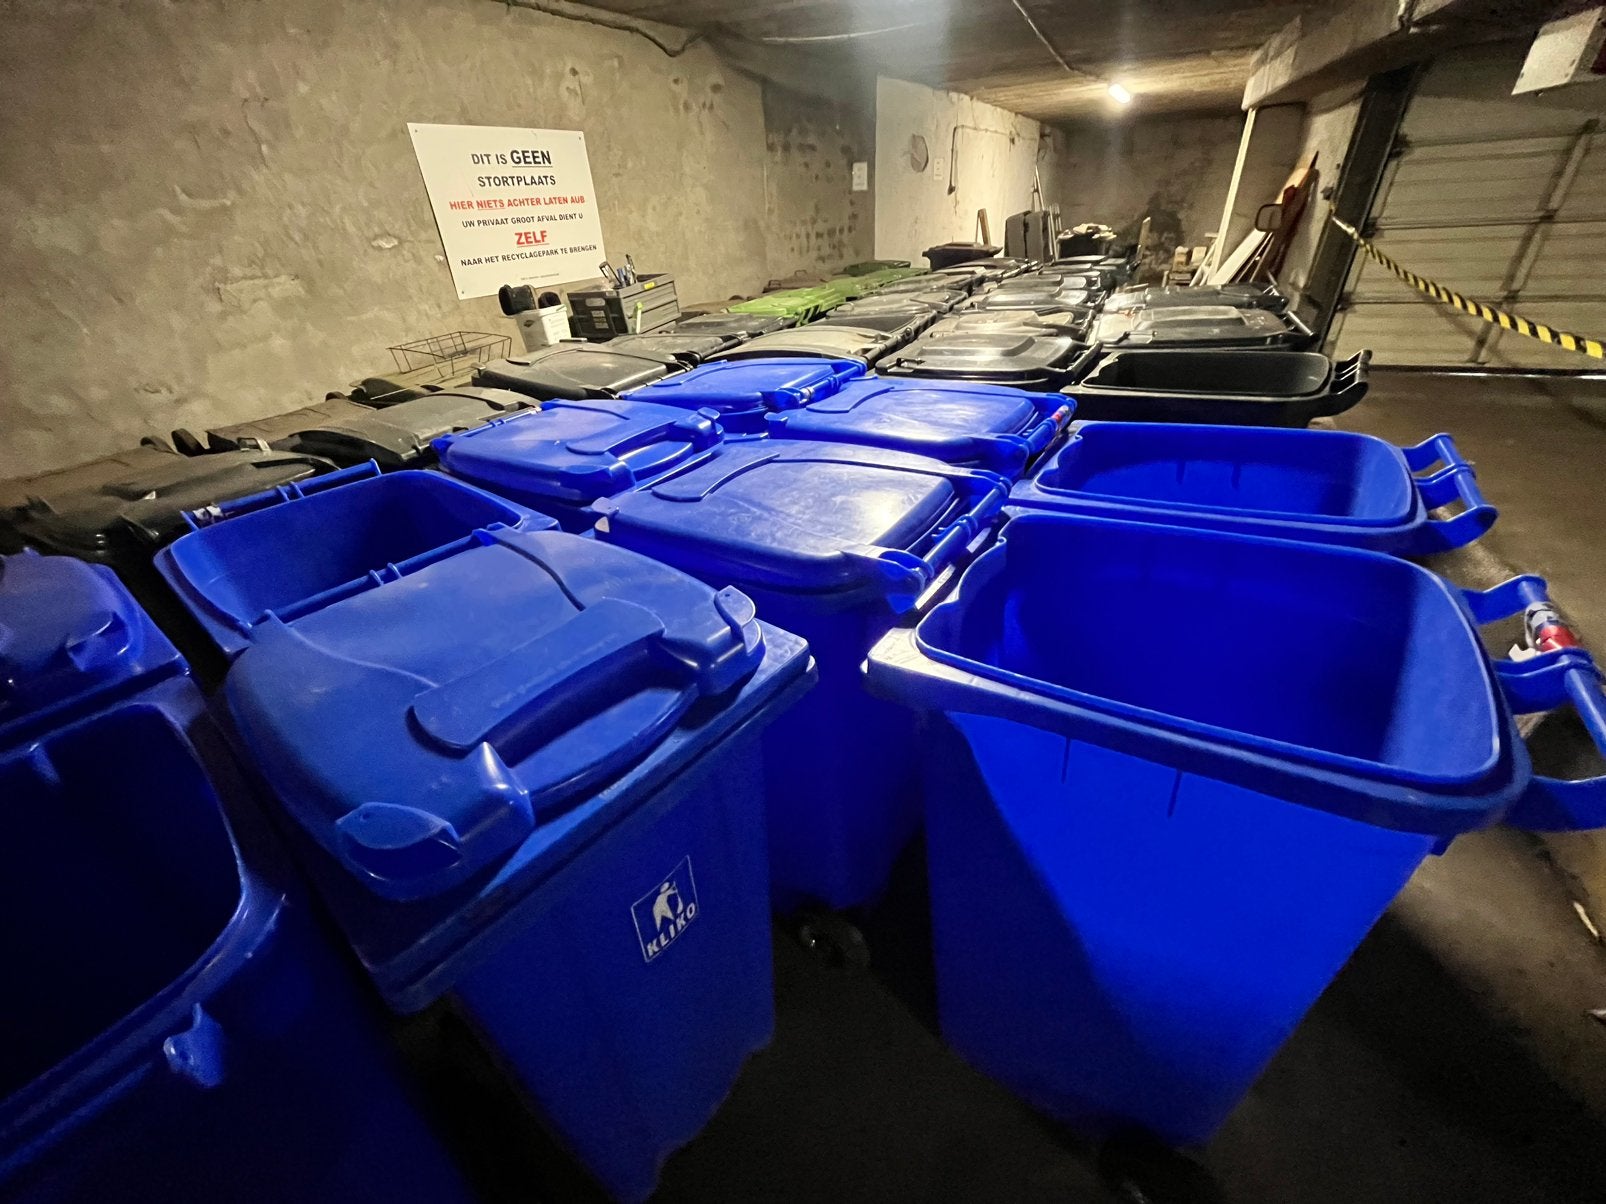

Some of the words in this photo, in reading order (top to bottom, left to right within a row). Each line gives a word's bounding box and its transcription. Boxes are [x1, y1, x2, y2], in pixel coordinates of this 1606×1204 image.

[471, 153, 492, 165] DIT
[495, 153, 508, 165] IS
[510, 149, 552, 165] GEEN
[477, 174, 556, 188] STORTPLAATS
[449, 200, 475, 211] HIER
[476, 199, 505, 209] NIETS
[507, 197, 541, 208] ACHTER
[543, 195, 569, 206] LATEN
[570, 195, 586, 204] AUB
[462, 220, 476, 229] UW
[477, 217, 509, 228] PRIVAAT
[511, 215, 536, 225] GROOT
[537, 214, 558, 223] AFVAL
[559, 213, 577, 221] DIENT
[515, 229, 548, 246] ZELF
[461, 257, 483, 267] NAAR
[485, 254, 500, 264] HET
[501, 249, 559, 262] RECYCLAGEPARK
[560, 247, 568, 255] TE
[569, 244, 597, 254] BRENGEN
[646, 902, 696, 957] KLIKO
